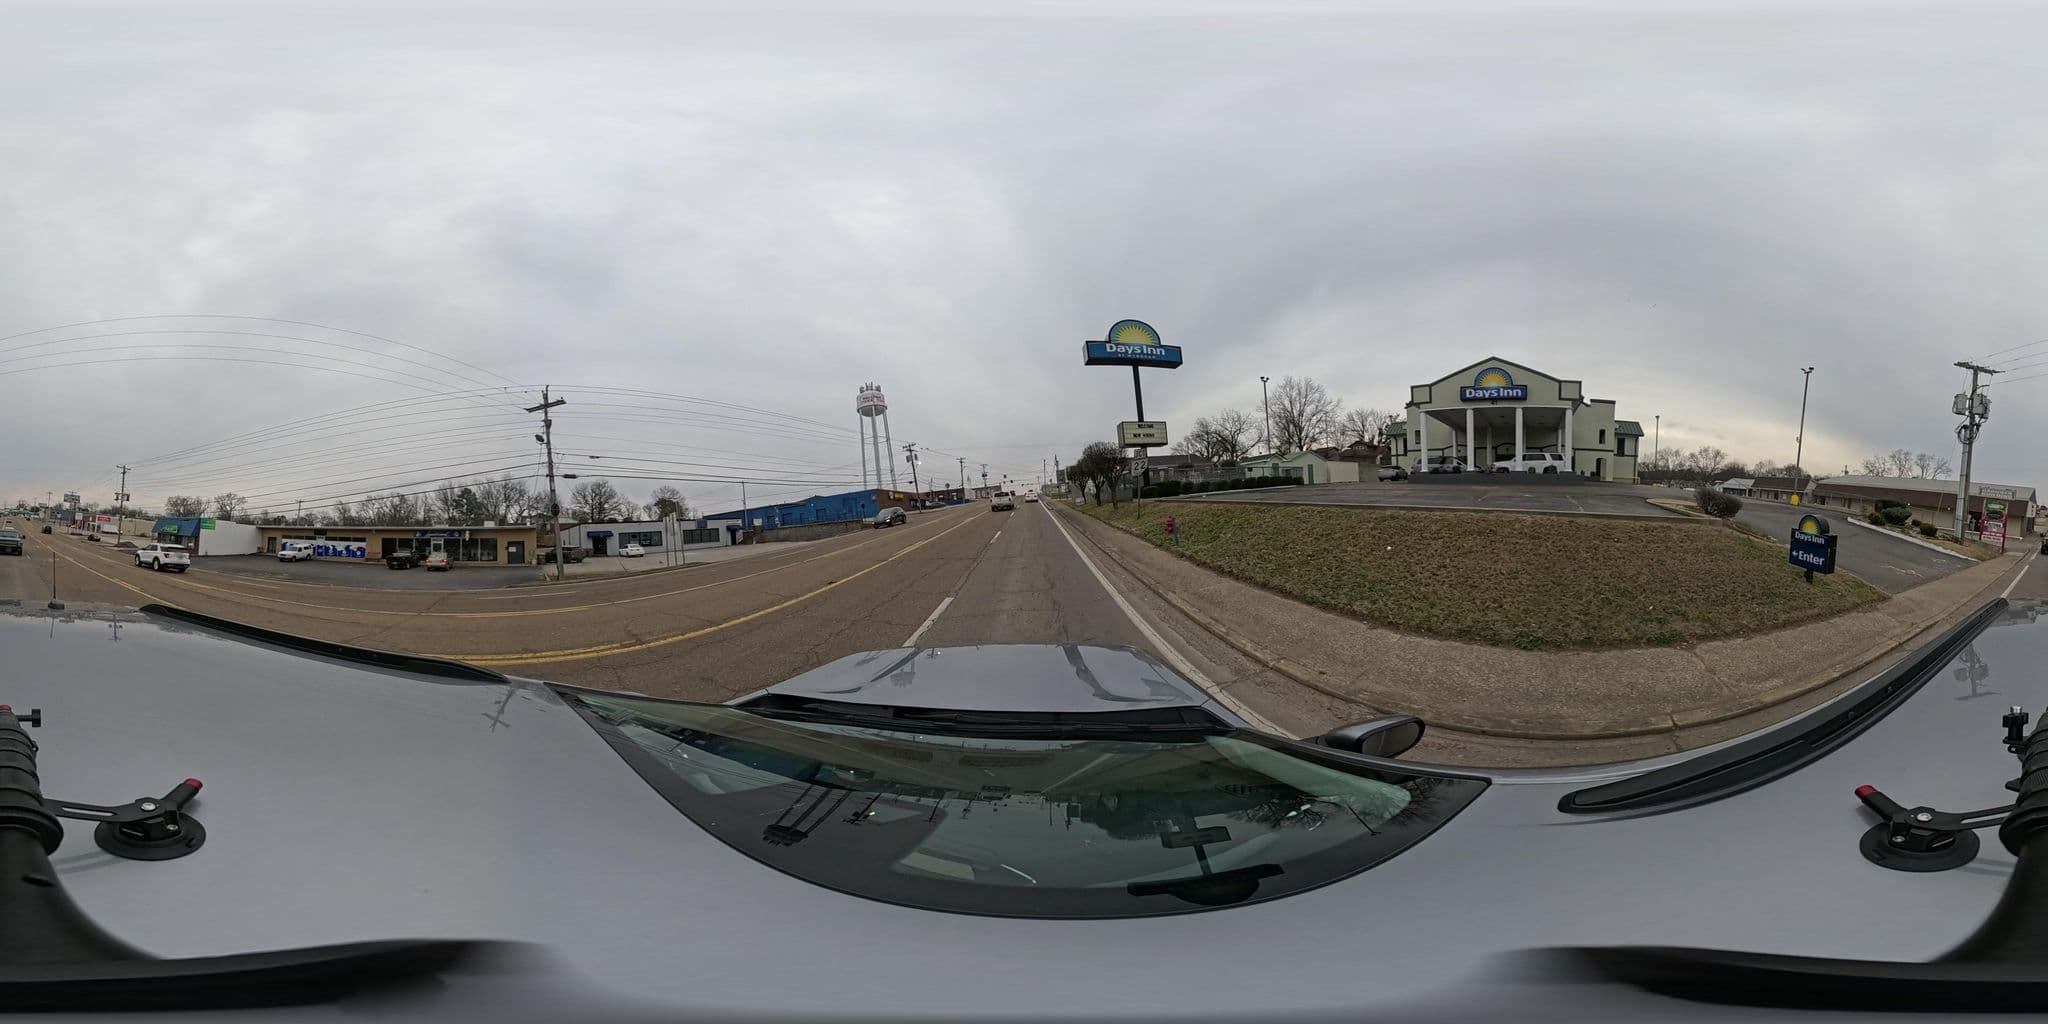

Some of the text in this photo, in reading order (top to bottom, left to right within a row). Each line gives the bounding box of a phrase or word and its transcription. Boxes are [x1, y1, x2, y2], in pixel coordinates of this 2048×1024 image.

[1106, 344, 1165, 355] Days Inn
[1466, 388, 1522, 398] Days Inn
[1134, 460, 1146, 470] 22
[1795, 532, 1824, 544] Days Inn
[1798, 550, 1825, 566] Enter
